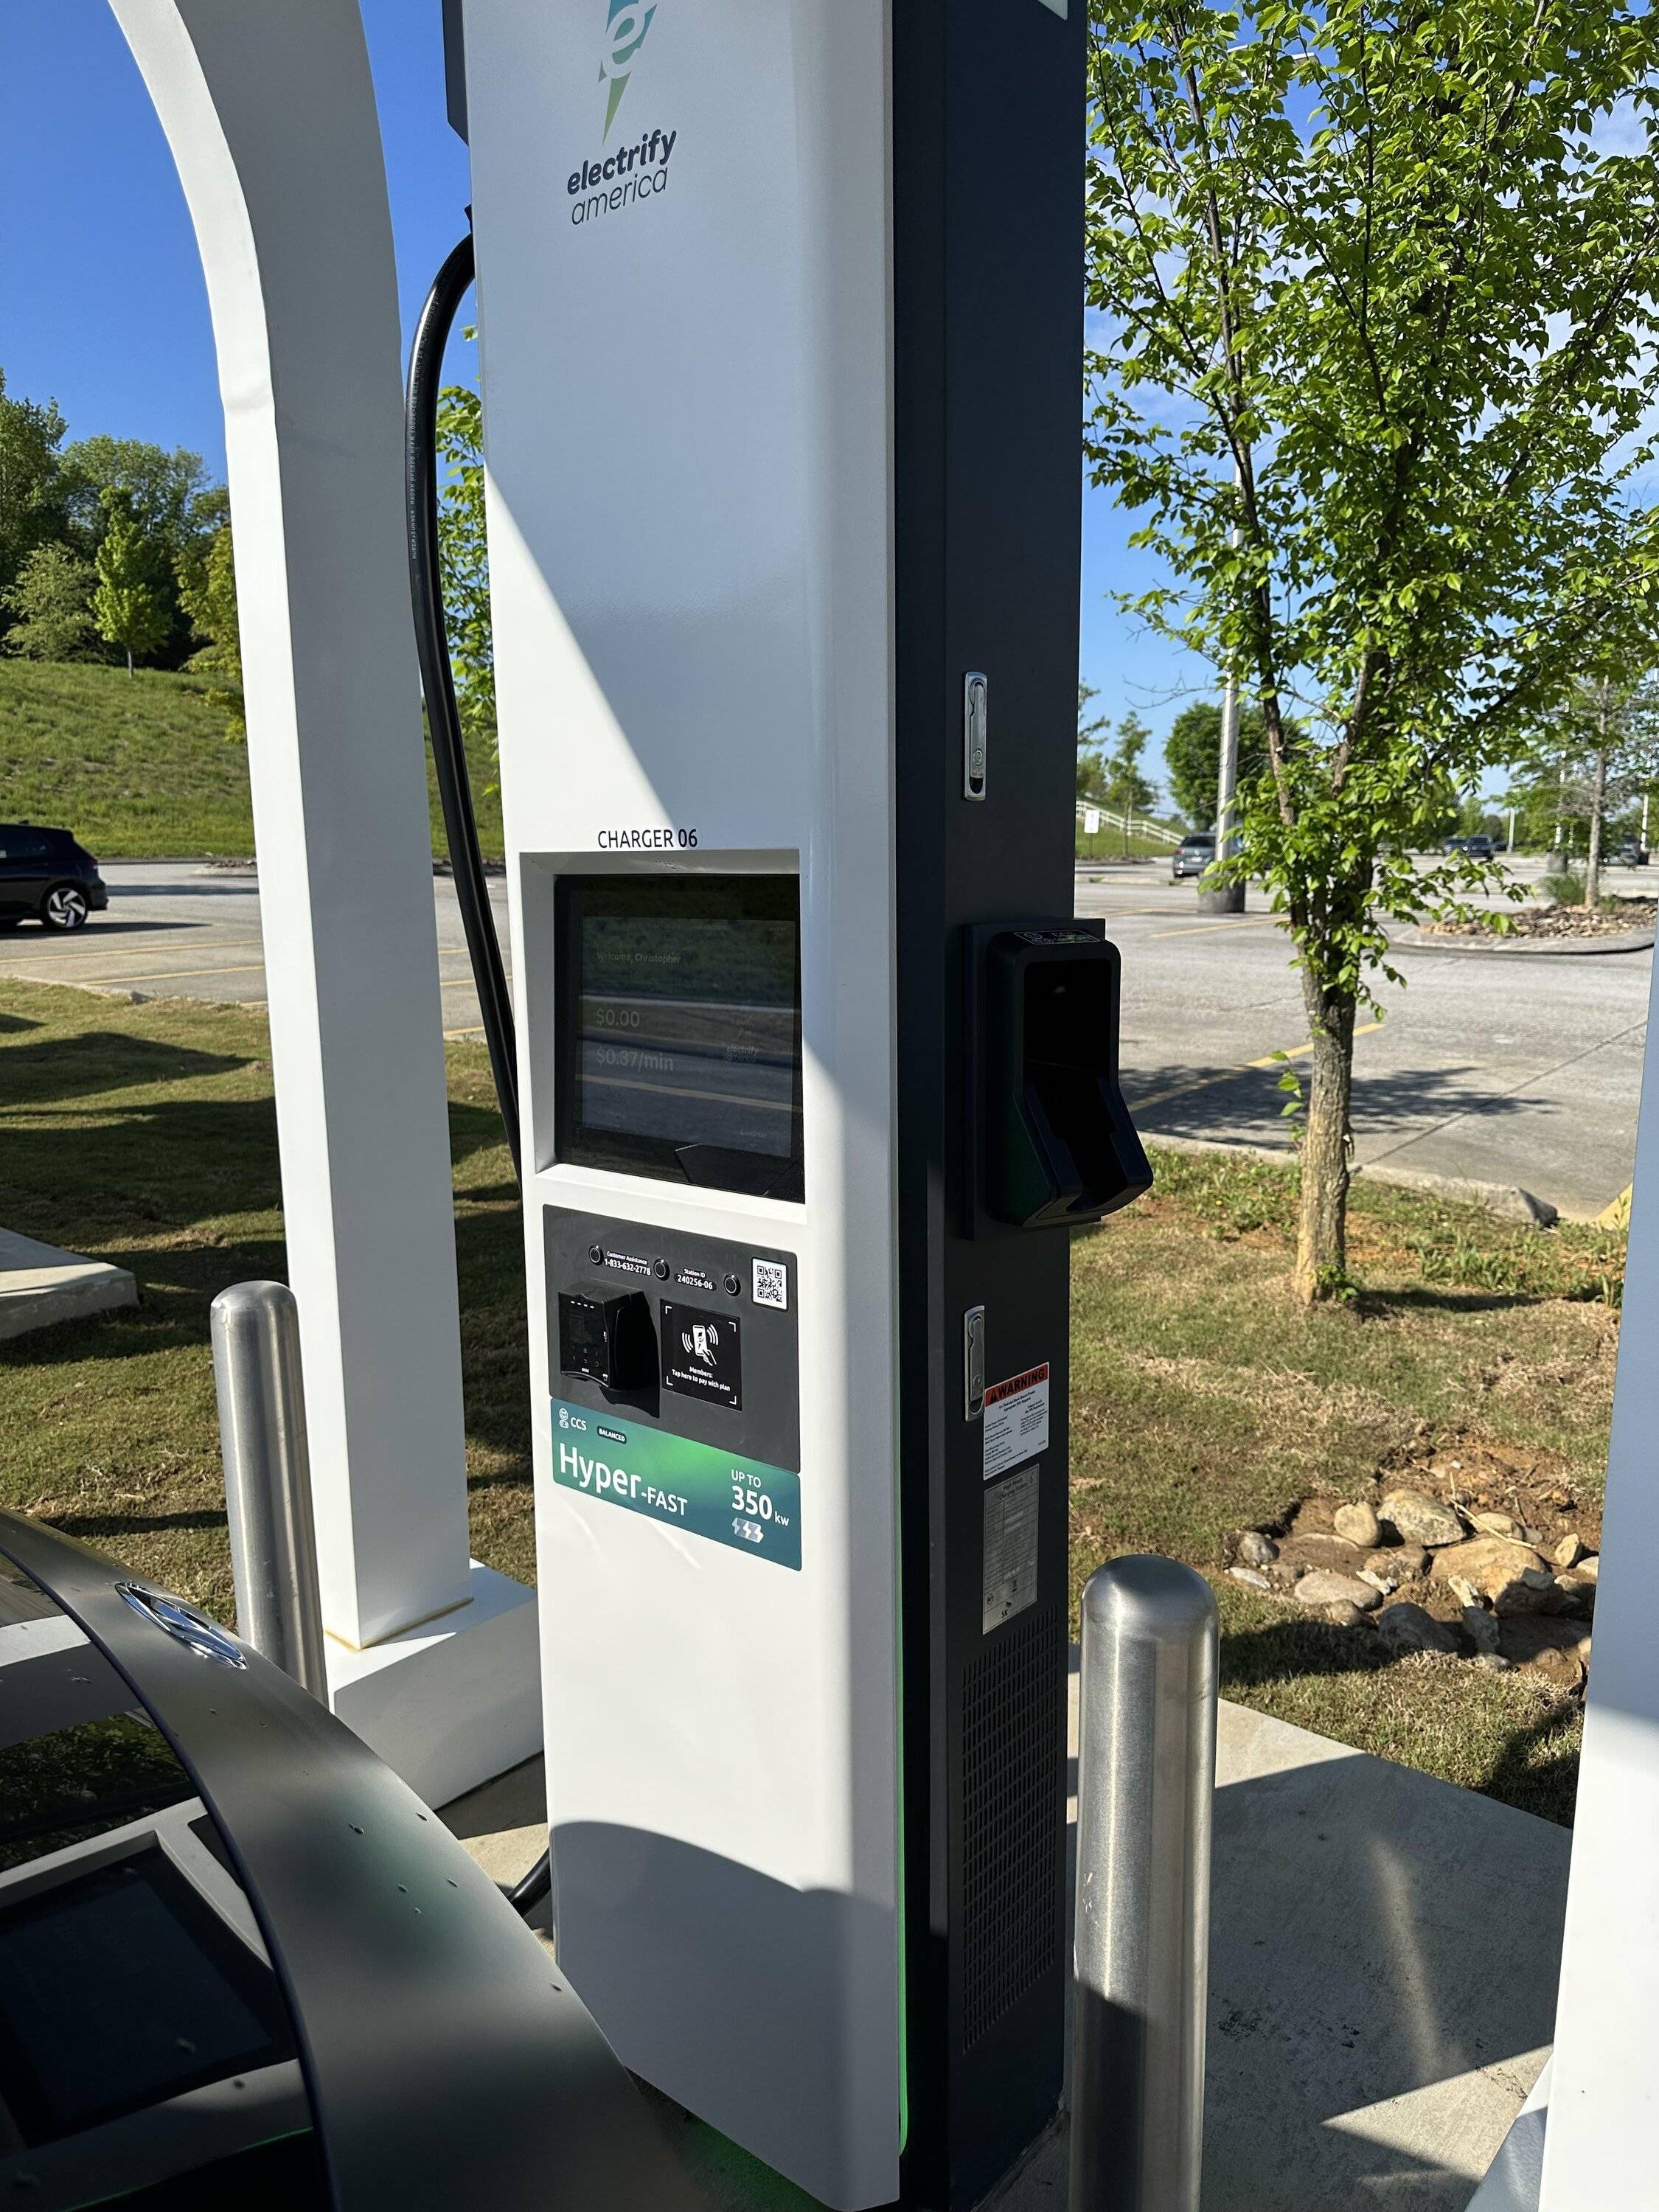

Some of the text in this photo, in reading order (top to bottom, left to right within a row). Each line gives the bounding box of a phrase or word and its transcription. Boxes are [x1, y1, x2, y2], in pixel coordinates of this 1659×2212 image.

[567, 129, 677, 195] electrify
[571, 167, 668, 225] america
[598, 828, 698, 849] CHARGER 06
[635, 953, 681, 964] Christopher
[597, 1007, 640, 1028] $0.00
[597, 1046, 673, 1072] $0.37/min
[605, 1258, 651, 1276] 1-833-632-2778
[607, 1251, 647, 1265] Customer Assistance
[678, 1274, 713, 1290] 240256-06
[684, 1268, 700, 1277] Station
[672, 1368, 681, 1378] Tap
[681, 1371, 692, 1380] here
[708, 1380, 719, 1388] with
[720, 1383, 731, 1391] plan
[689, 1366, 713, 1378] Members:
[998, 1368, 1045, 1399] WARNING
[570, 1417, 625, 1442] CCS BALANCED
[731, 1469, 761, 1488] UP TO
[731, 1485, 773, 1520] 350
